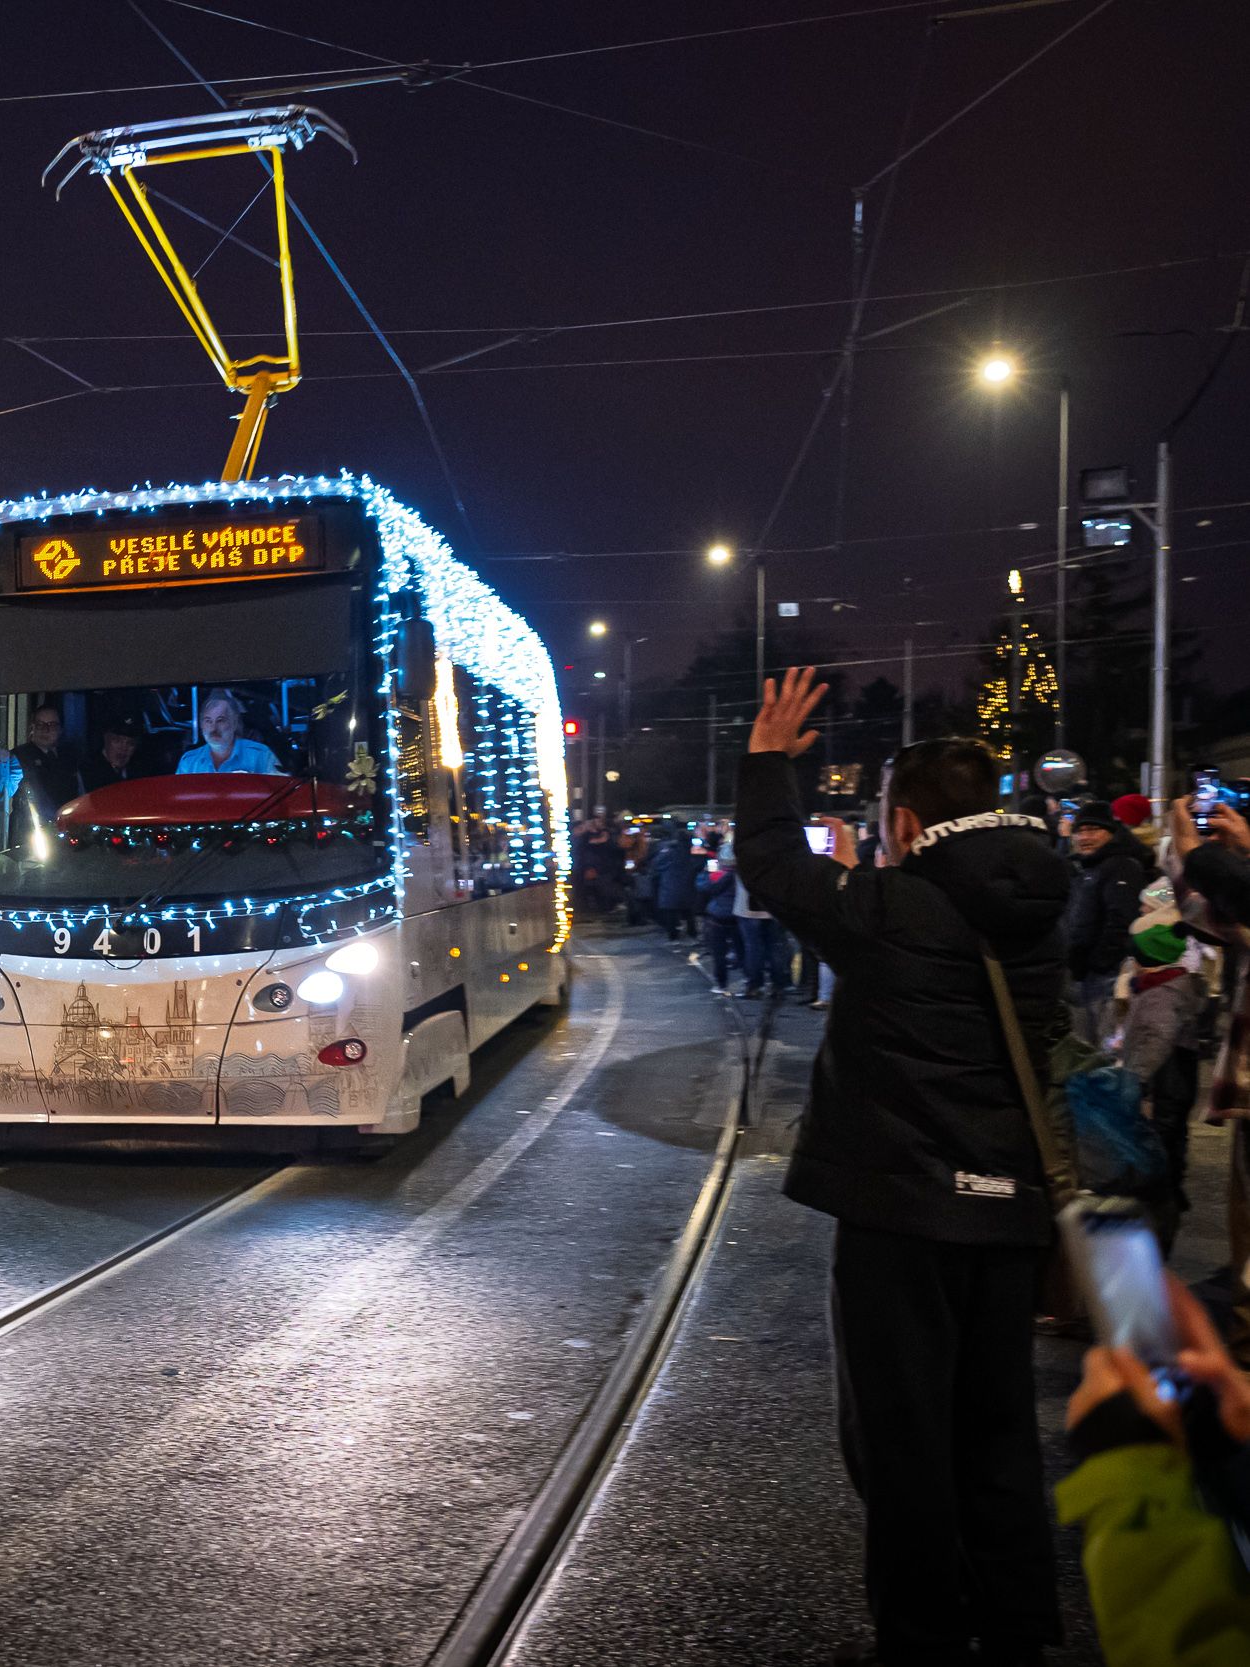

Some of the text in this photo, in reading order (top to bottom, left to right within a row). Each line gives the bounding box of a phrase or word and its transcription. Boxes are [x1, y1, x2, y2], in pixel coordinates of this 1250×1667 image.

[110, 525, 296, 555] VESELÉ VÁNOCE
[103, 545, 304, 576] PŘEJE VÁŠ DPP
[53, 925, 201, 955] 9401
